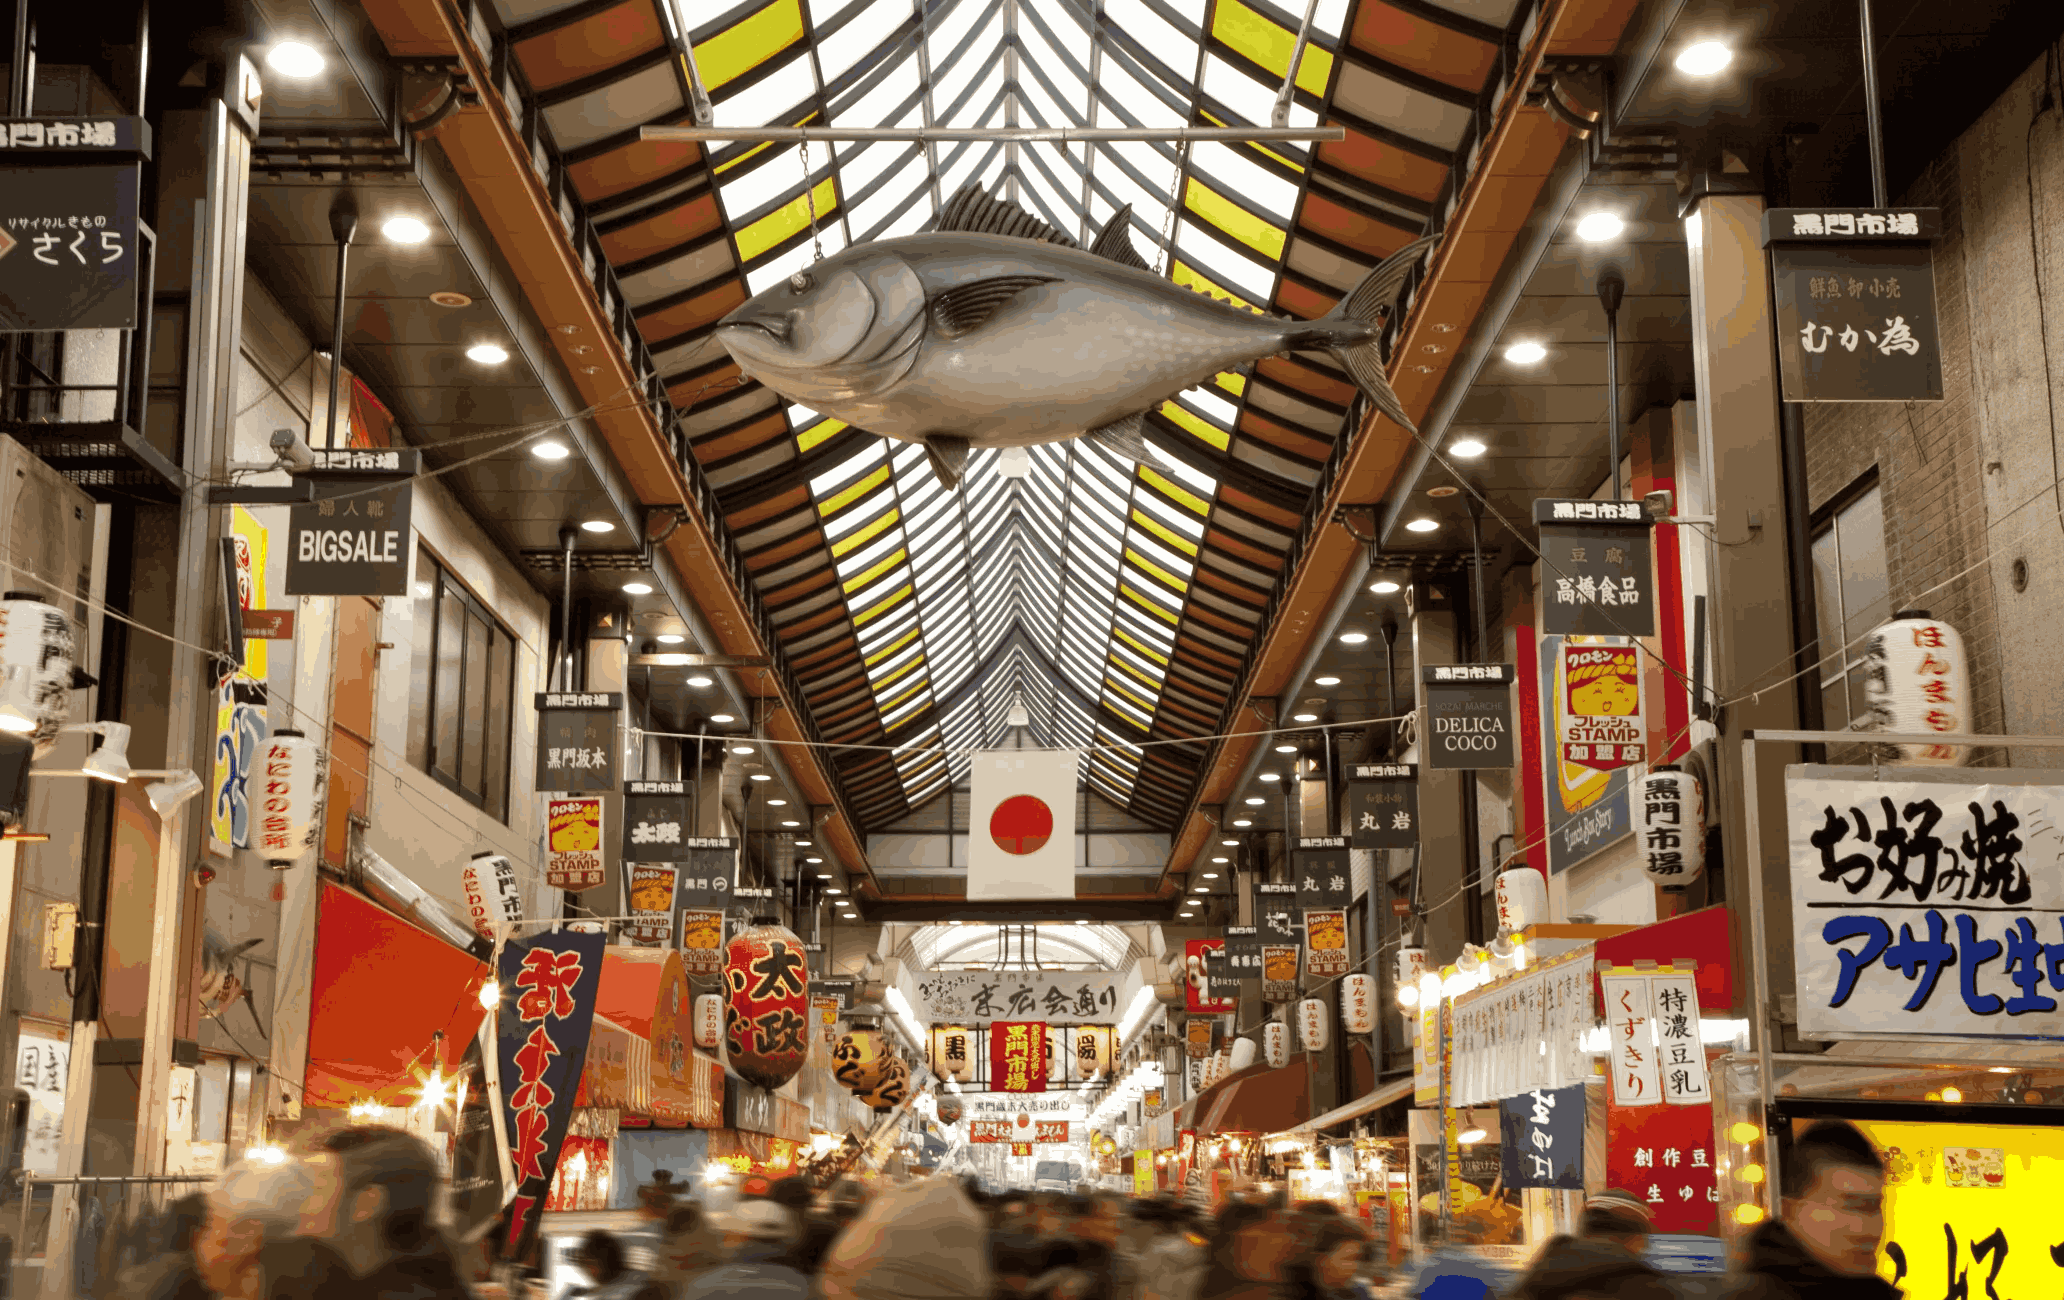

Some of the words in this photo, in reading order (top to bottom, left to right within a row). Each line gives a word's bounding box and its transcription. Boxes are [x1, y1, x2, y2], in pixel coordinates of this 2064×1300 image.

[0, 121, 116, 147] 門市場
[9, 215, 107, 229] リサイクルきもの
[1792, 212, 1919, 235] 黒門市場
[32, 230, 124, 265] さくら
[1799, 315, 1920, 356] むか為
[1553, 502, 1641, 520] 黒門市場
[298, 529, 400, 563] BIGSALE
[1570, 547, 1623, 564] 豆腐
[1556, 575, 1640, 606] 高橋食品
[1566, 651, 1614, 668] クロモン
[1435, 666, 1503, 680] 黒門市場
[546, 693, 610, 707] 黒門市場
[1435, 716, 1505, 734] DELICA
[1573, 715, 1632, 728] フレッシュ
[1444, 735, 1498, 752] COCO
[1568, 727, 1640, 742] STAMP
[547, 747, 607, 769] 黒門坂本
[1569, 743, 1641, 762] 加盟店
[1356, 765, 1411, 777] 黒門市場
[631, 782, 684, 794] 黒門市場
[1359, 810, 1412, 830] 丸岩
[1644, 777, 1685, 876] 黒門市場
[631, 821, 682, 844] 太政
[1300, 837, 1345, 848] 黒門市場
[1810, 796, 2032, 904] お好み焼
[549, 859, 600, 870] STAMP
[1302, 875, 1346, 892] 丸岩
[682, 954, 720, 962] STAMP
[1309, 955, 1346, 963] STAMP
[748, 939, 806, 1056] 太政
[1352, 977, 1369, 1029] ほんまもん
[945, 1034, 966, 1061] 黒
[1614, 988, 1646, 1098] くずきり
[1658, 987, 1702, 1095] 特濃豆乳
[1004, 1024, 1029, 1091] 黒門市場
